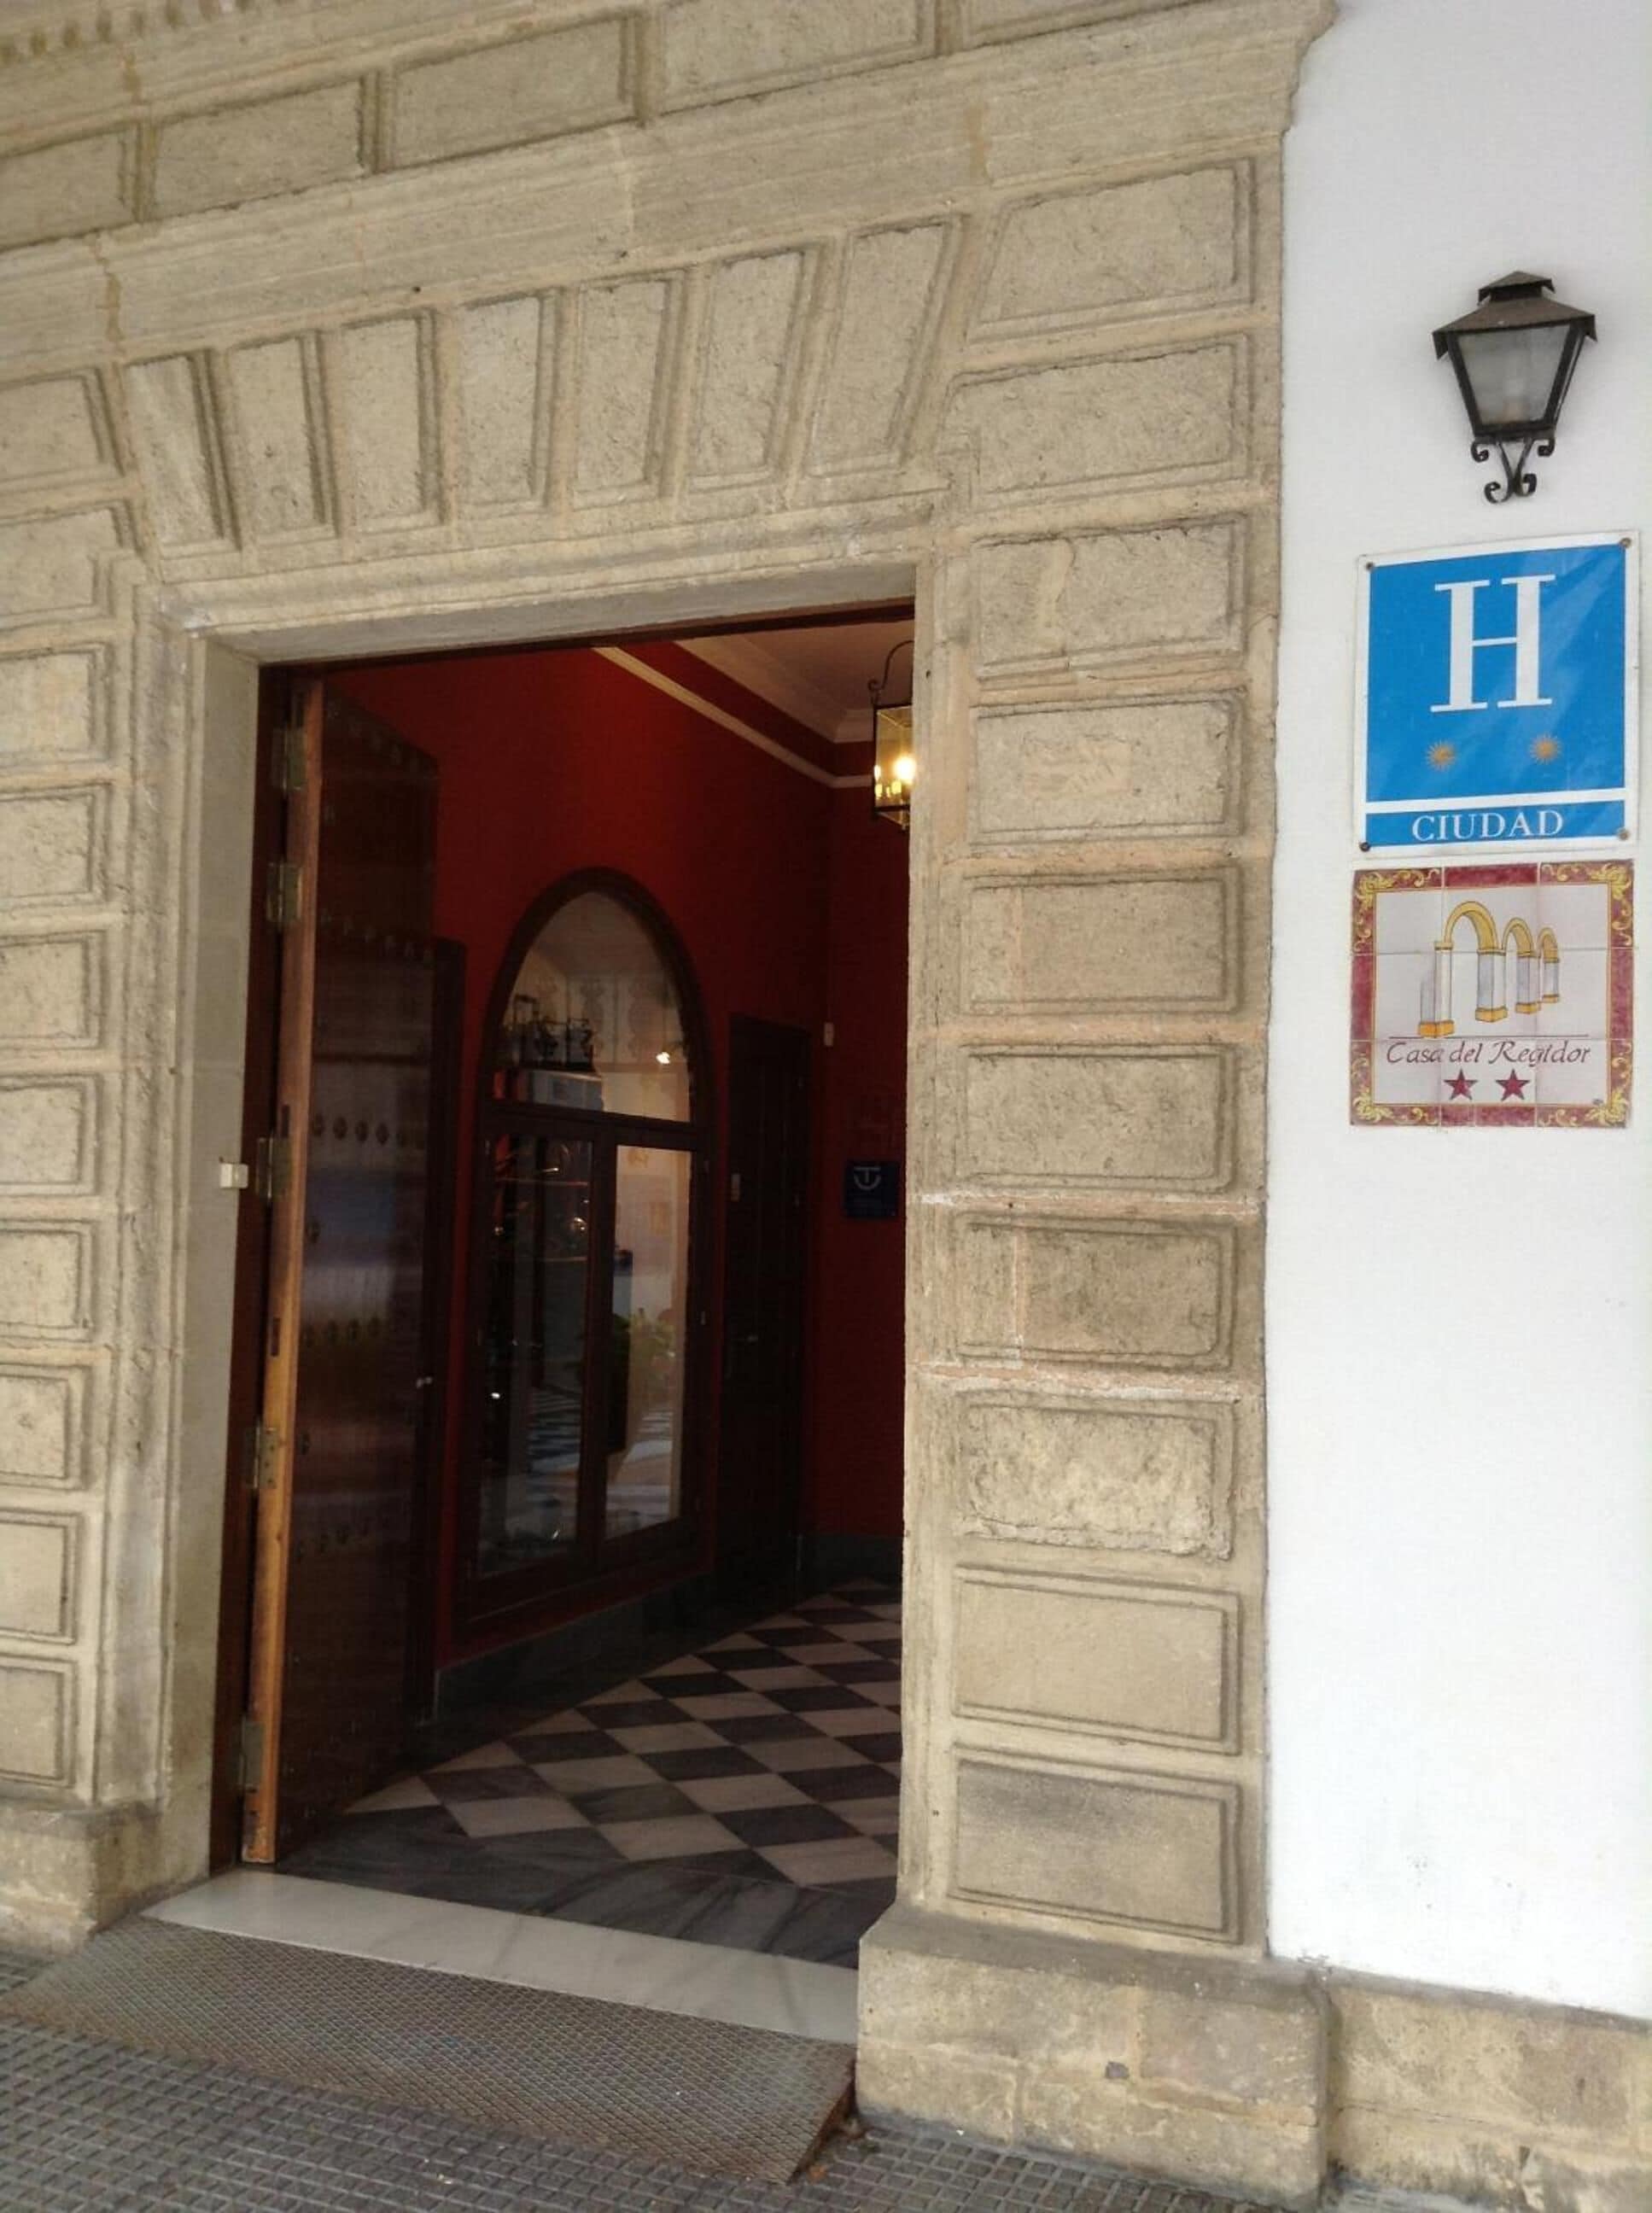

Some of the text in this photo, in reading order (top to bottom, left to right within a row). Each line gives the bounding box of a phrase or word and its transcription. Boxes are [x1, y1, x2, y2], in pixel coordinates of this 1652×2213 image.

[1430, 574, 1556, 713] H
[1411, 809, 1564, 842] CIUDAD
[1386, 1039, 1591, 1067] Casa del Regidor
